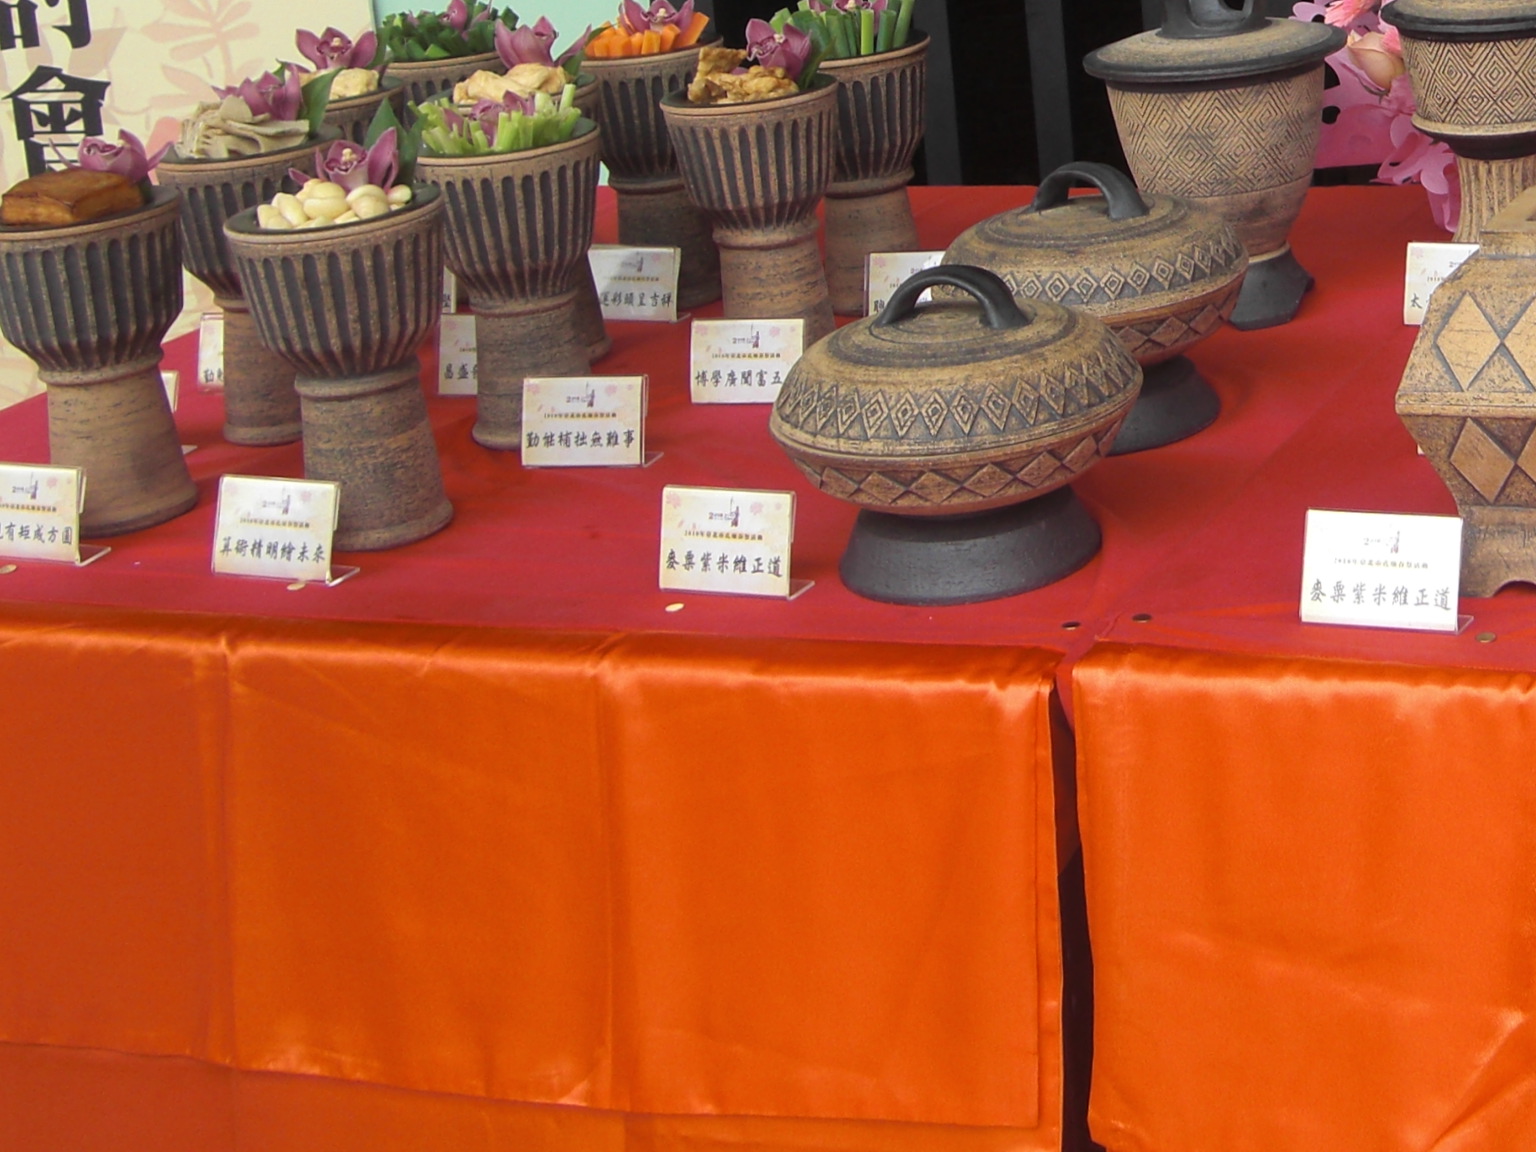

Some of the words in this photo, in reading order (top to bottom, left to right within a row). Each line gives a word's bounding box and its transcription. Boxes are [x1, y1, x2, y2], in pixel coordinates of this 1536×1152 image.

[0, 521, 73, 546] 有矩成方圓
